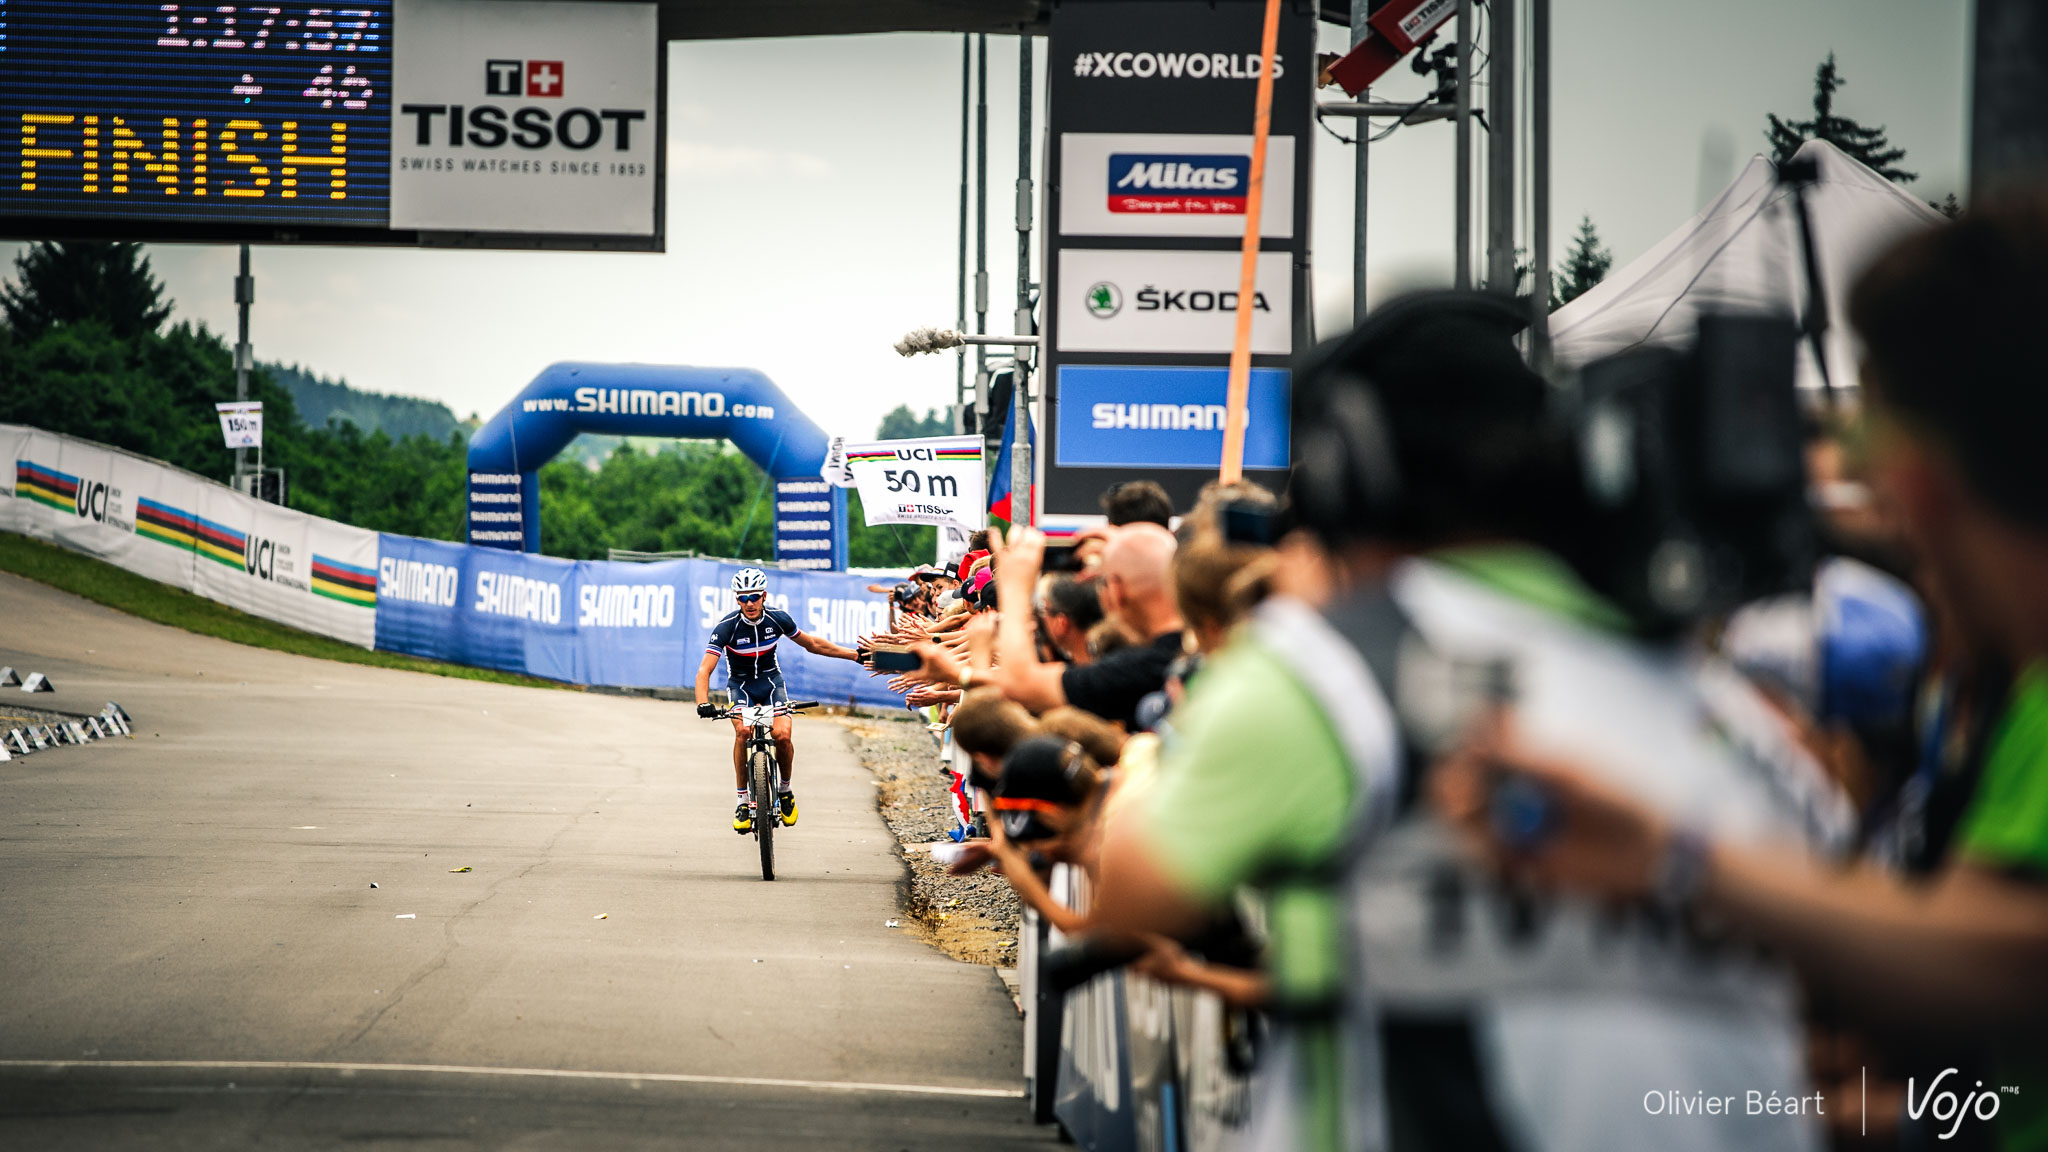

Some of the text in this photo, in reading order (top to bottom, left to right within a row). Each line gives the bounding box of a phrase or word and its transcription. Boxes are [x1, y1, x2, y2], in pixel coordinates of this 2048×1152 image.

[1073, 51, 1285, 79] #XCOWORLDS
[401, 103, 646, 151] TISSOT
[21, 114, 347, 199] FINISH
[400, 158, 455, 172] SWISS
[463, 159, 542, 174] WATCHES
[551, 161, 600, 175] SINCE
[1117, 162, 1238, 189] Mitas
[1136, 284, 1271, 312] ŠKODA
[523, 387, 775, 420] www.SHIMANO.com
[1092, 402, 1249, 430] SHIMAN
[897, 448, 933, 461] UCI
[884, 469, 957, 496] 50 m
[78, 478, 109, 523] UCI
[247, 534, 275, 581] UCI
[380, 557, 459, 608] SHIMANO
[474, 571, 562, 625] SHIMANO
[579, 584, 675, 627] SHIMANO
[700, 586, 790, 629] SHIO
[753, 706, 764, 717] 2
